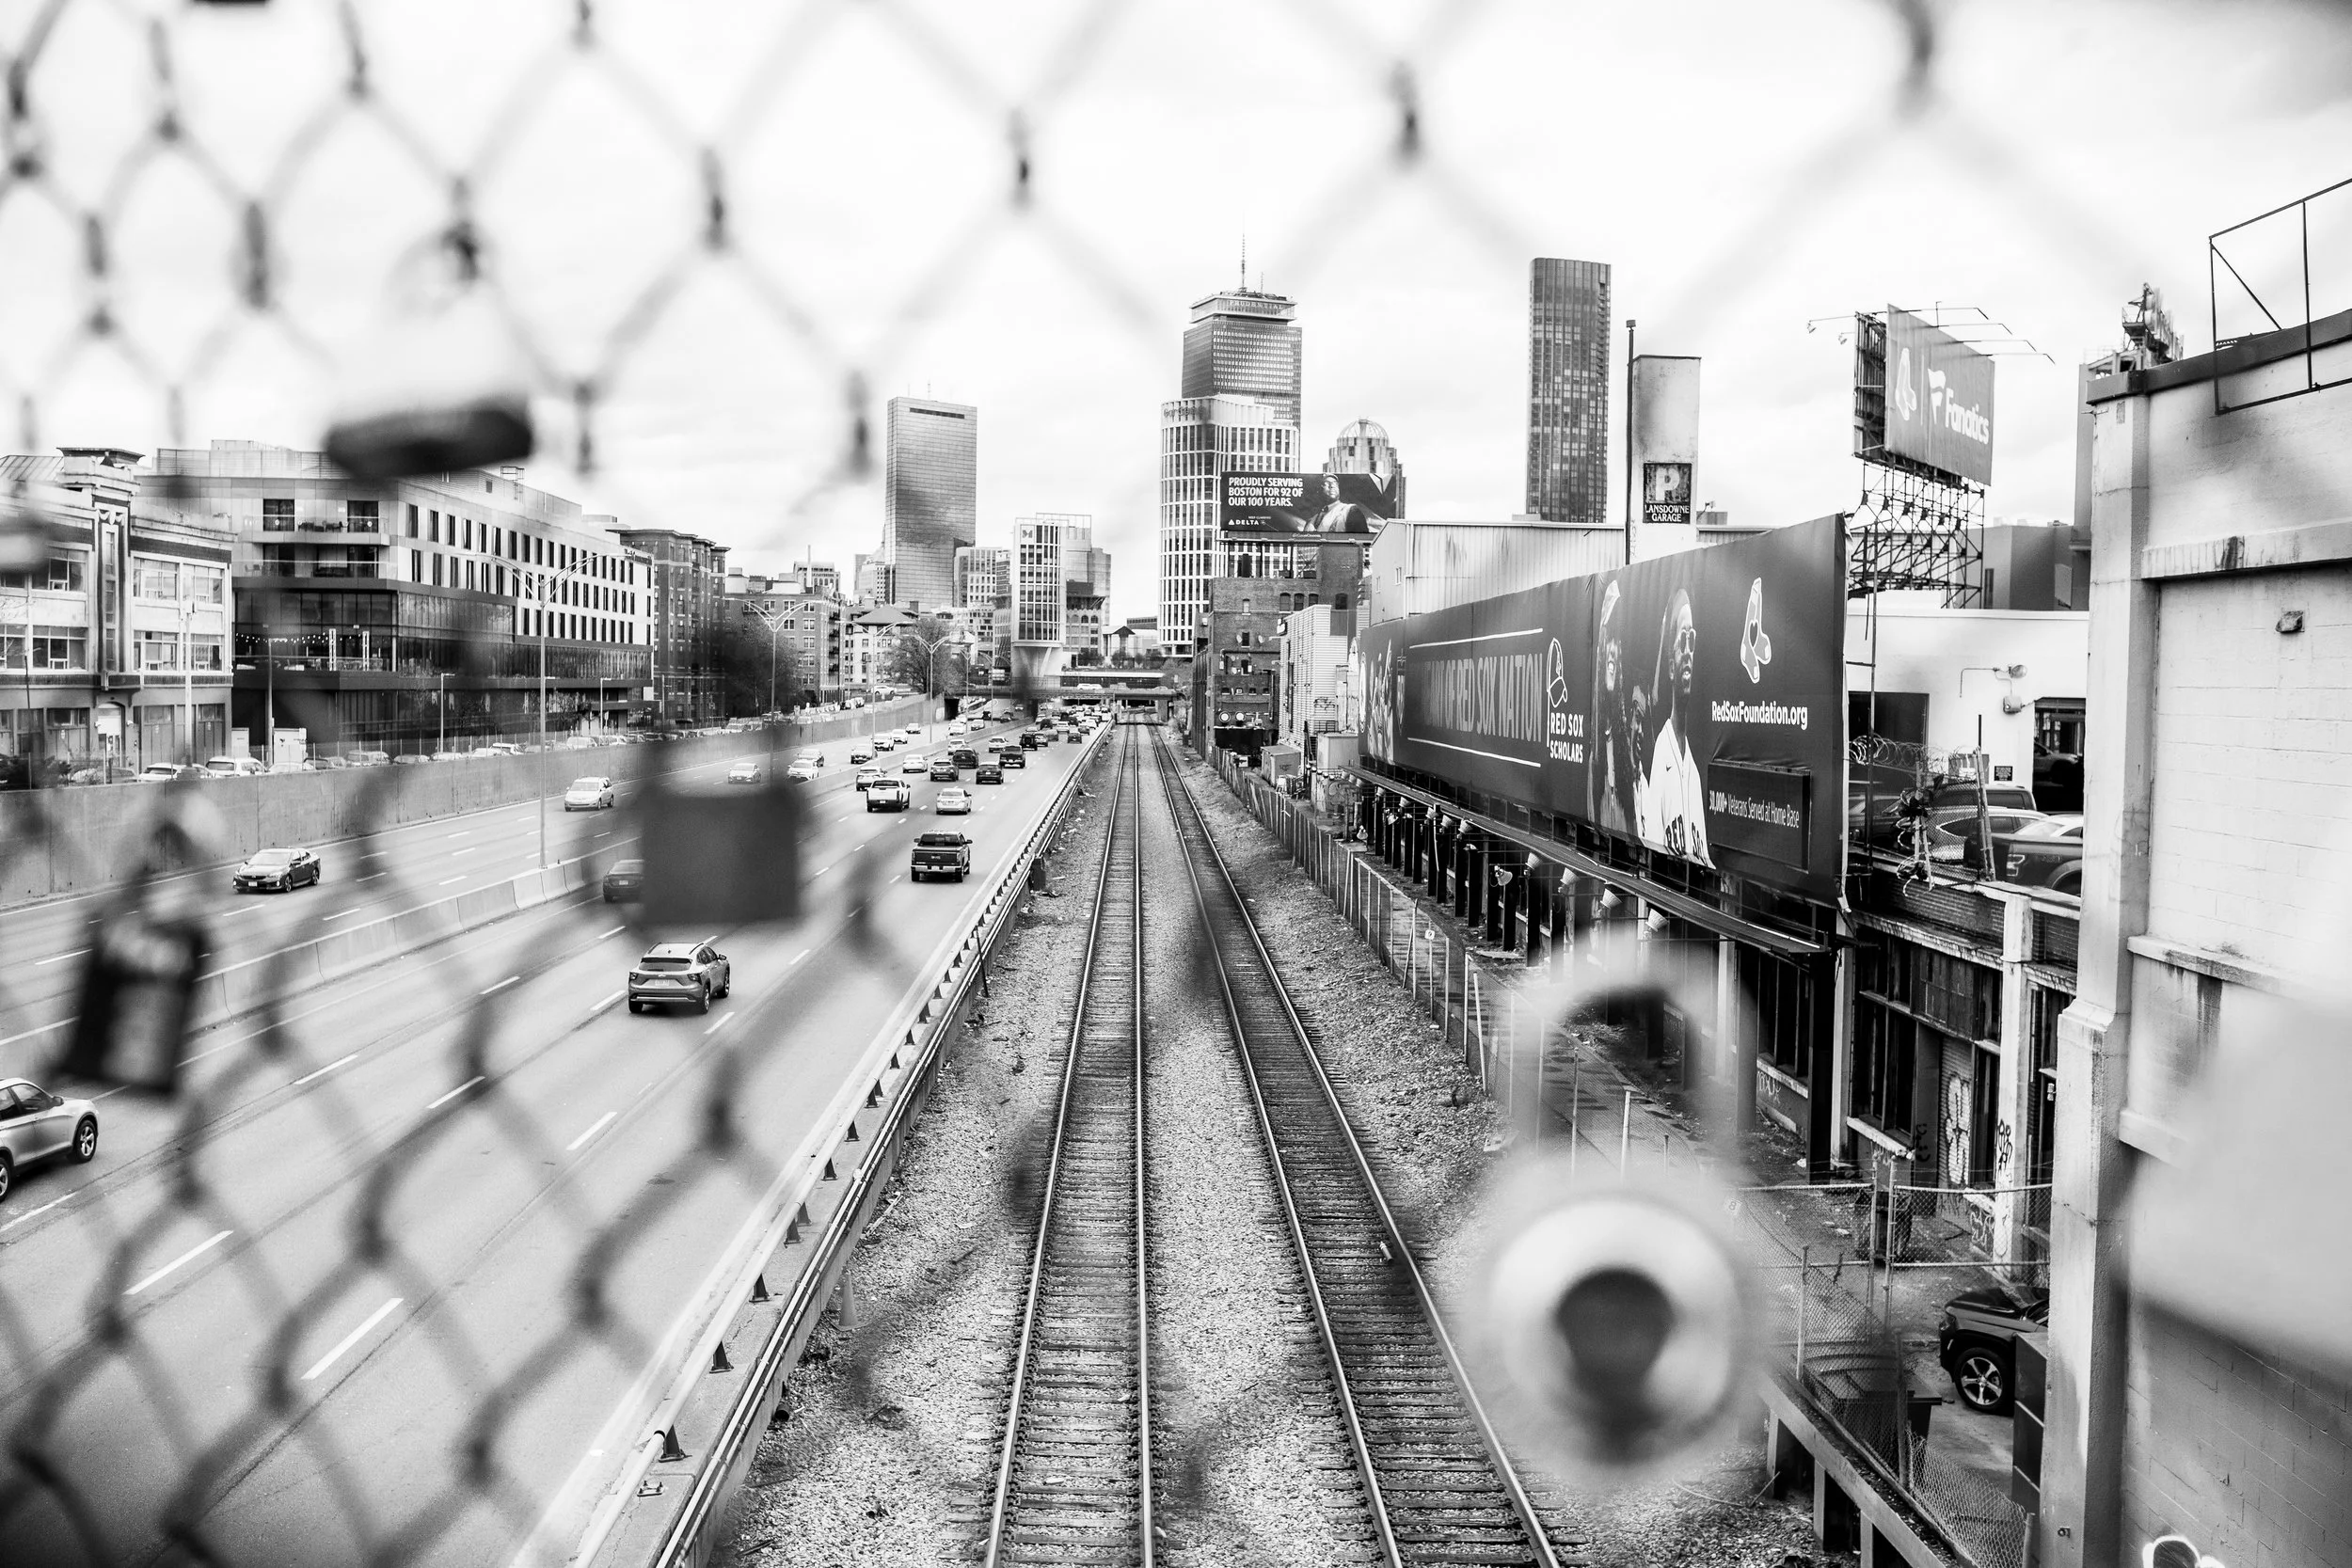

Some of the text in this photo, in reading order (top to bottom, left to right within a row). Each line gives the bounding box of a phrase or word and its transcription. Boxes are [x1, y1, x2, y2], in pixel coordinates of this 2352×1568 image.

[1945, 387, 1990, 445] Fanatics
[1228, 476, 1304, 487] PROUDLY SERVING
[1228, 486, 1304, 497] BOSTON FOR 92 OF
[1655, 467, 1680, 501] P
[1228, 497, 1294, 507] OUR 100 YEARS.
[1645, 504, 1690, 514] LANSDOWNE
[1651, 514, 1682, 522] GARAGE
[1445, 659, 1456, 730] OF
[1456, 657, 1475, 732] RED
[1476, 657, 1498, 736] SOX
[1499, 653, 1543, 743] NATION
[1549, 712, 1584, 738] RED SOX
[1711, 700, 1808, 731] RedSoxFoundation.org
[1549, 739, 1583, 764] SCHOLARS
[1727, 793, 1748, 817] Veterans
[1748, 797, 1765, 821] Served
[1765, 800, 1771, 823] at
[1771, 800, 1787, 826] Home
[1787, 803, 1800, 829] Base
[1663, 814, 1687, 857] RED
